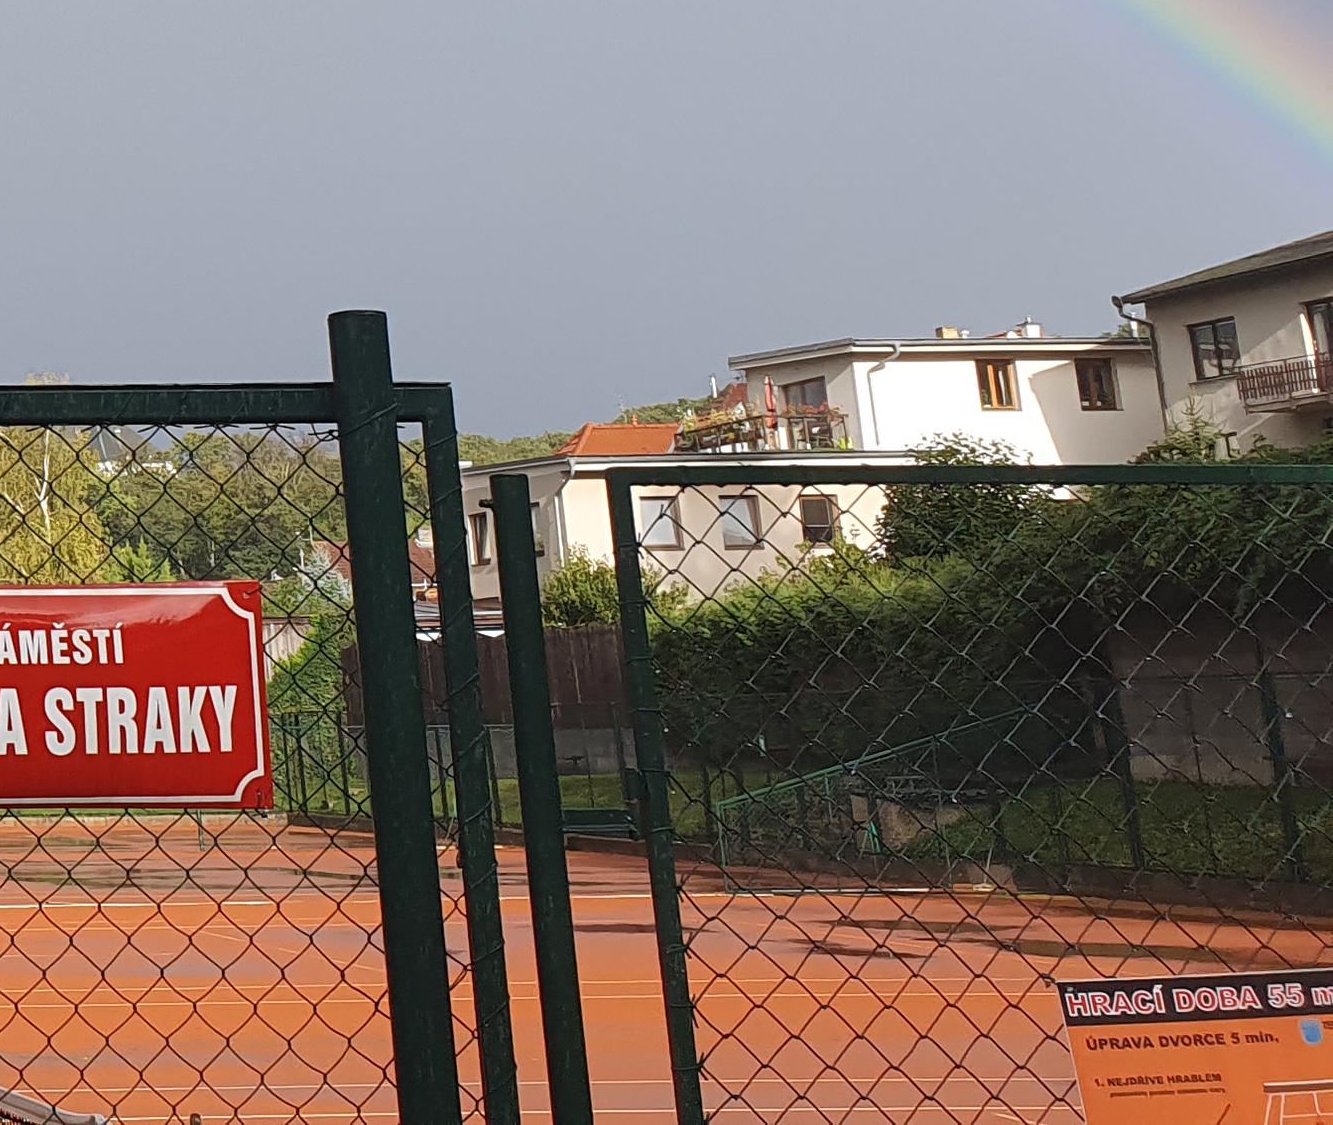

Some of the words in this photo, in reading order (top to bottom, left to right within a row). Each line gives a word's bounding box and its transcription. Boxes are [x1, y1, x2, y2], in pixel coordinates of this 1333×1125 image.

[44, 684, 238, 757] STRAKY
[1065, 984, 1165, 1018] HRACÍ
[1172, 985, 1262, 1013] DOBA
[1267, 983, 1305, 1008] 55
[1086, 1034, 1155, 1051] ÚPRAVA
[1159, 1032, 1226, 1048] DVORCE
[1230, 1031, 1241, 1044] 5
[1244, 1030, 1280, 1044] min.
